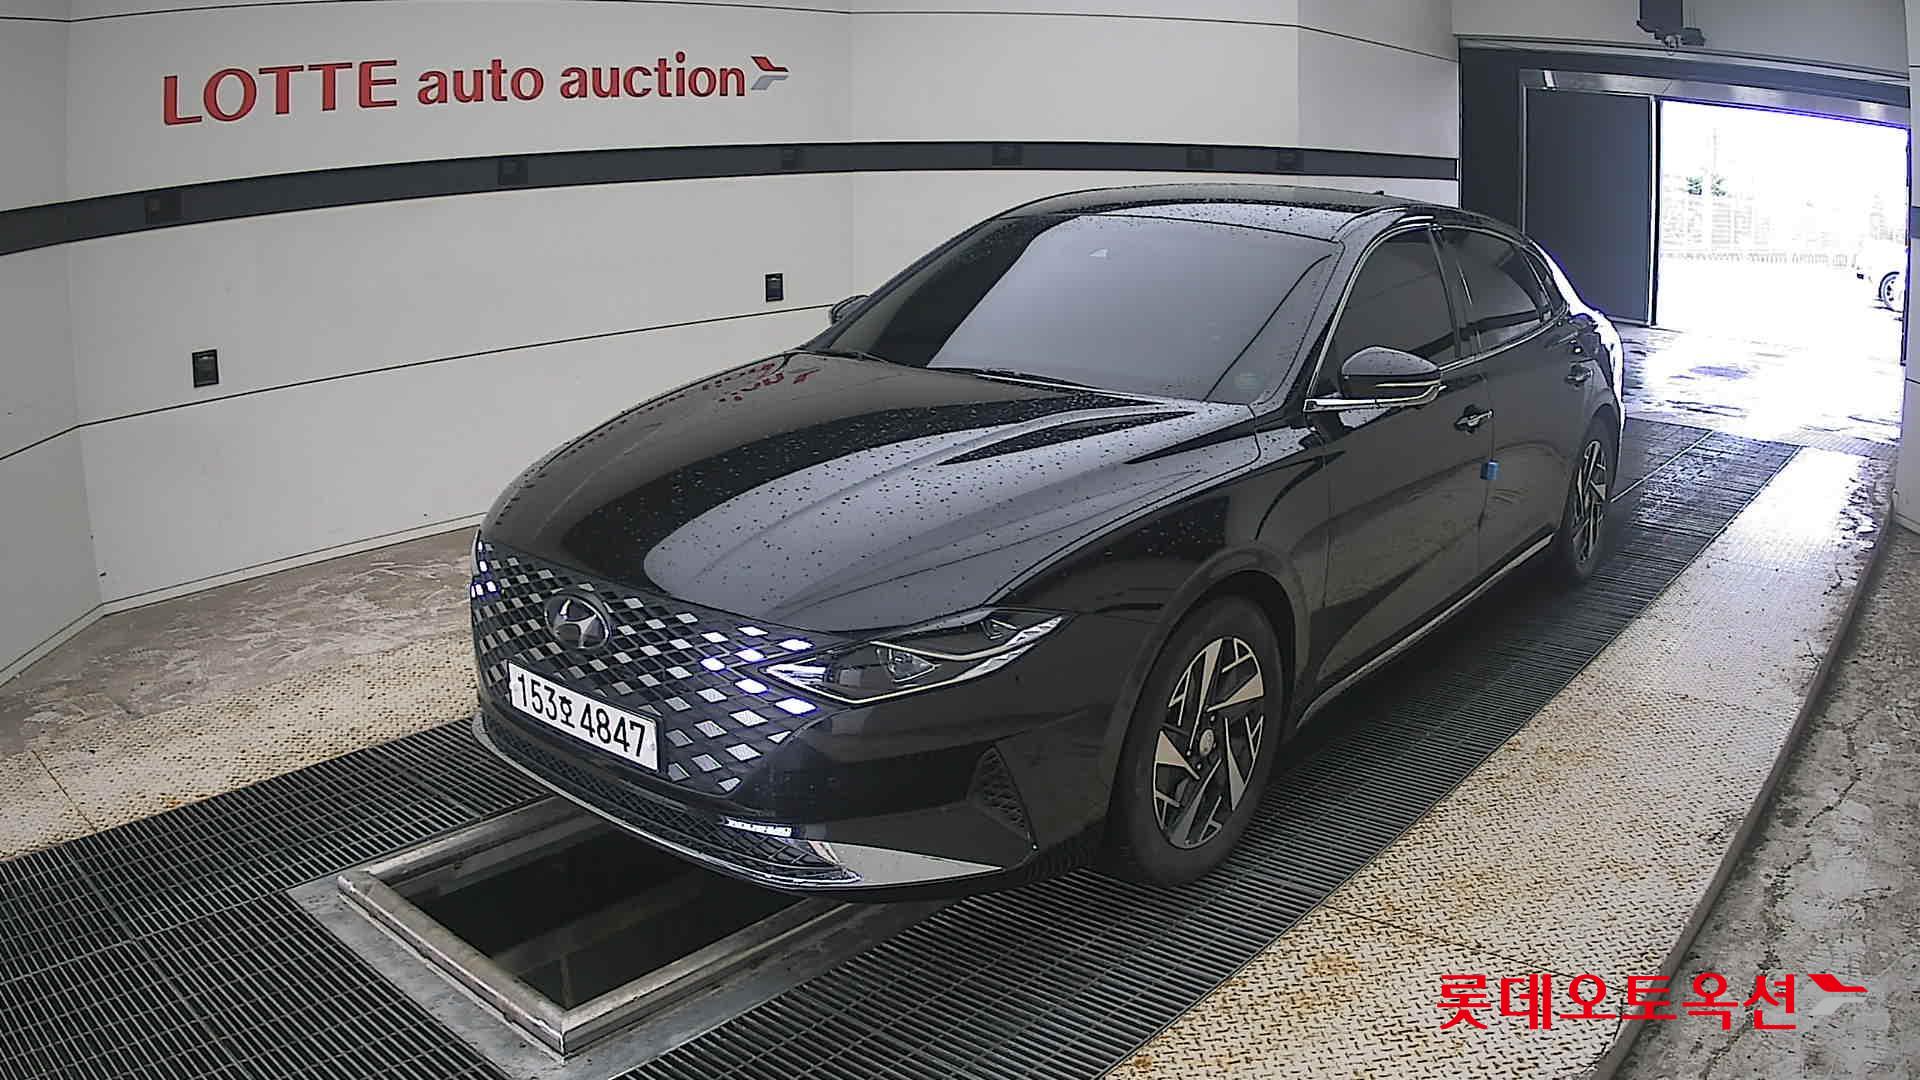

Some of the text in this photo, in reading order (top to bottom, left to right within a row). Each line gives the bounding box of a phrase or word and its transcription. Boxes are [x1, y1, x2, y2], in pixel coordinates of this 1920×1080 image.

[162, 51, 747, 126] LOTTE auto auction
